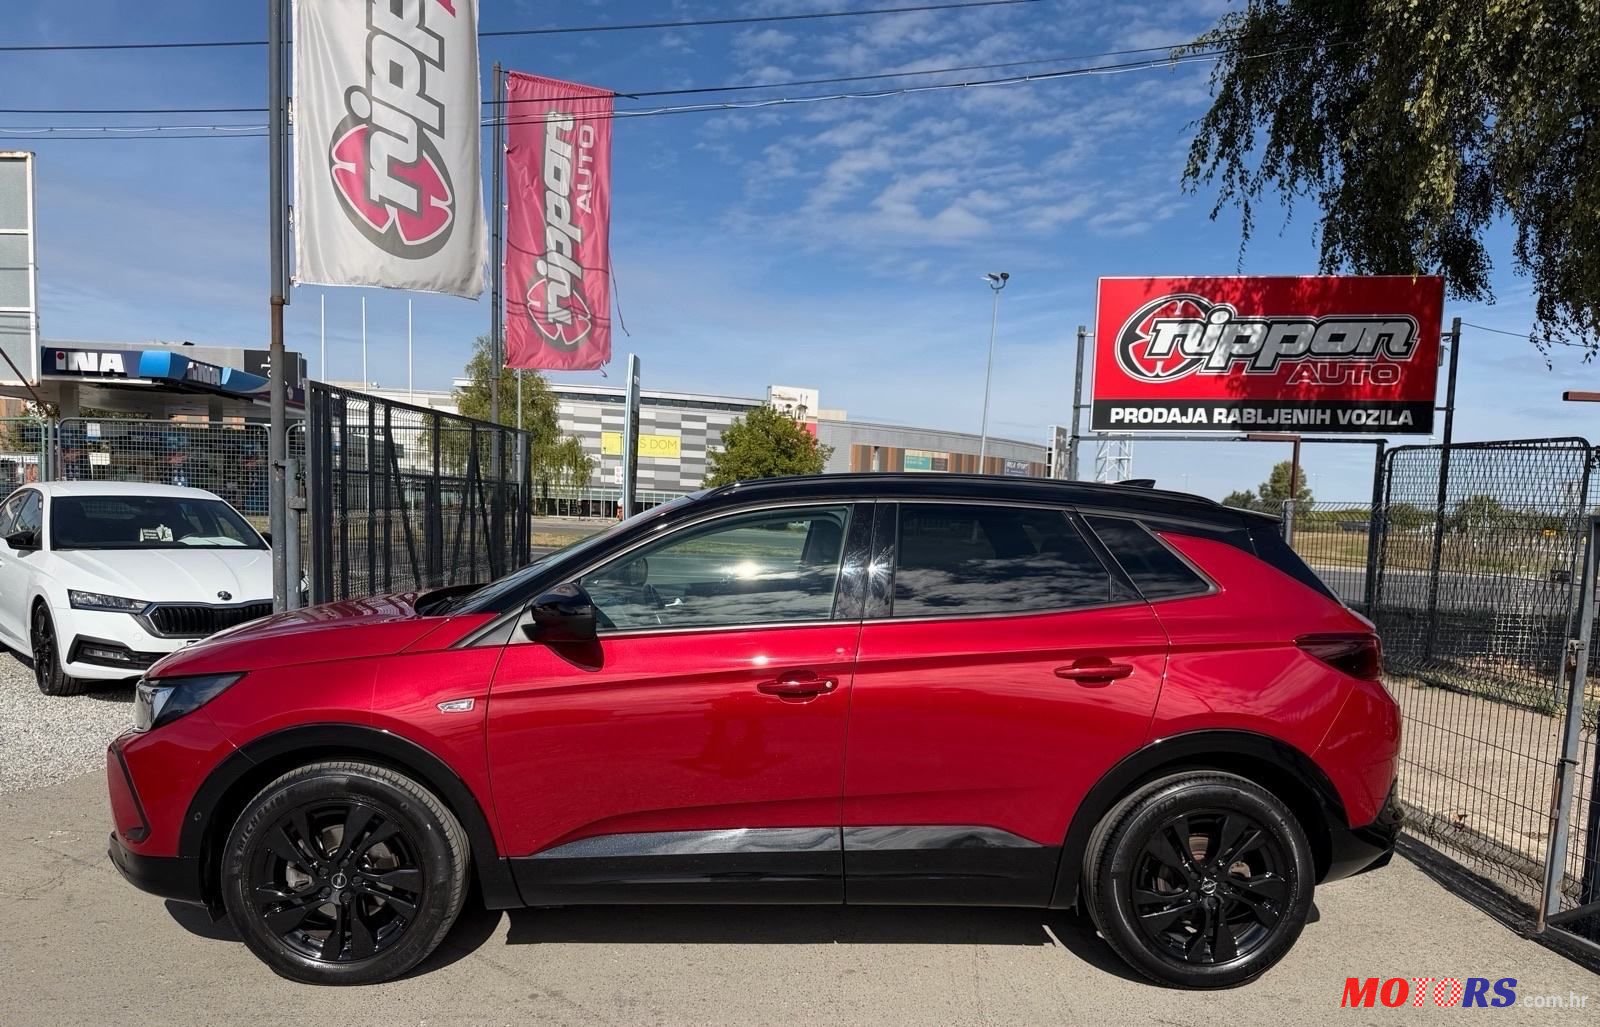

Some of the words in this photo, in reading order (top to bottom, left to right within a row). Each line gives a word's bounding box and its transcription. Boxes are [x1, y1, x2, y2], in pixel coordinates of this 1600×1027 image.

[576, 124, 594, 214] AUTO
[1146, 307, 1418, 371] nippon
[1286, 362, 1401, 386] AUTO
[1110, 407, 1208, 425] PRODAJA
[1213, 408, 1331, 426] RABLJENIH
[1336, 408, 1414, 426] VOZILA
[236, 793, 288, 852] MICHELIN
